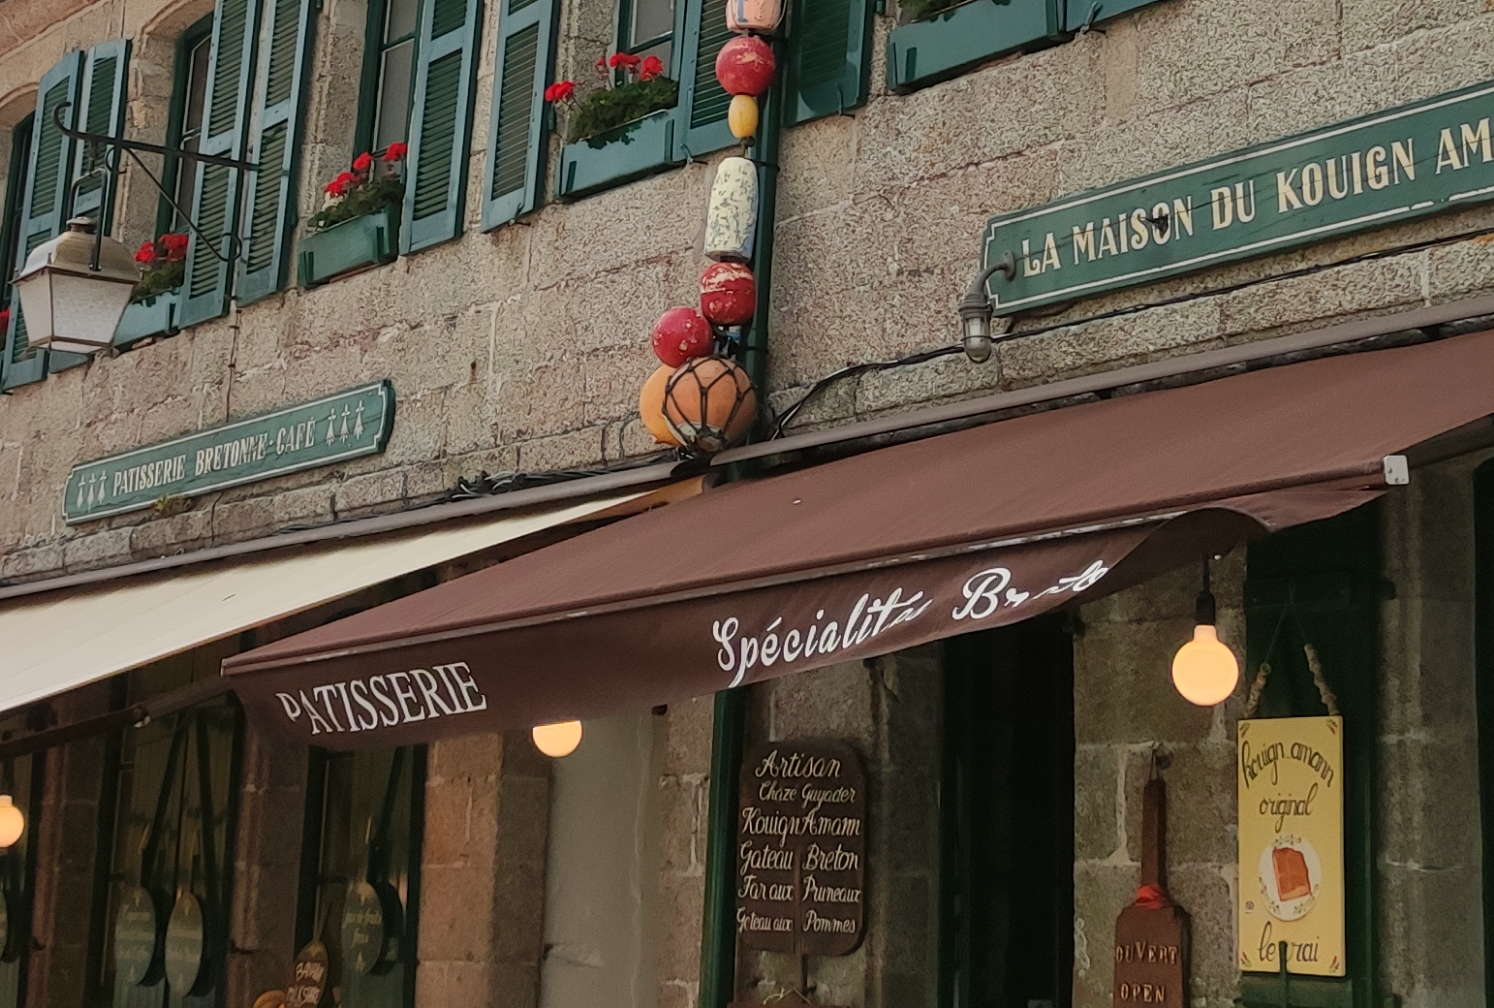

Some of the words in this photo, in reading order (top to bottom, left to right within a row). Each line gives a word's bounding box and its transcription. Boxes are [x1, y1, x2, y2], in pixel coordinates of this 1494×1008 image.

[1022, 232, 1061, 278] LA
[1072, 195, 1194, 265] MAISON
[1210, 179, 1256, 231] DU
[1276, 137, 1415, 214] KOUIGN
[112, 454, 187, 497] PATISSERIE
[275, 661, 487, 735] PATISSERIE
[754, 749, 841, 779] Artisan
[742, 806, 801, 848] Kouign
[801, 807, 861, 837] Amann
[1259, 782, 1319, 834] original
[739, 841, 794, 876] Gateau
[802, 841, 860, 871] Breton
[769, 883, 795, 901] aux
[802, 874, 863, 903] Pruneaux
[772, 917, 794, 932] aux
[802, 909, 857, 934] Pommes
[1115, 940, 1178, 965] OUVERT
[1257, 920, 1277, 963] le
[1120, 983, 1165, 1004] OPEN
